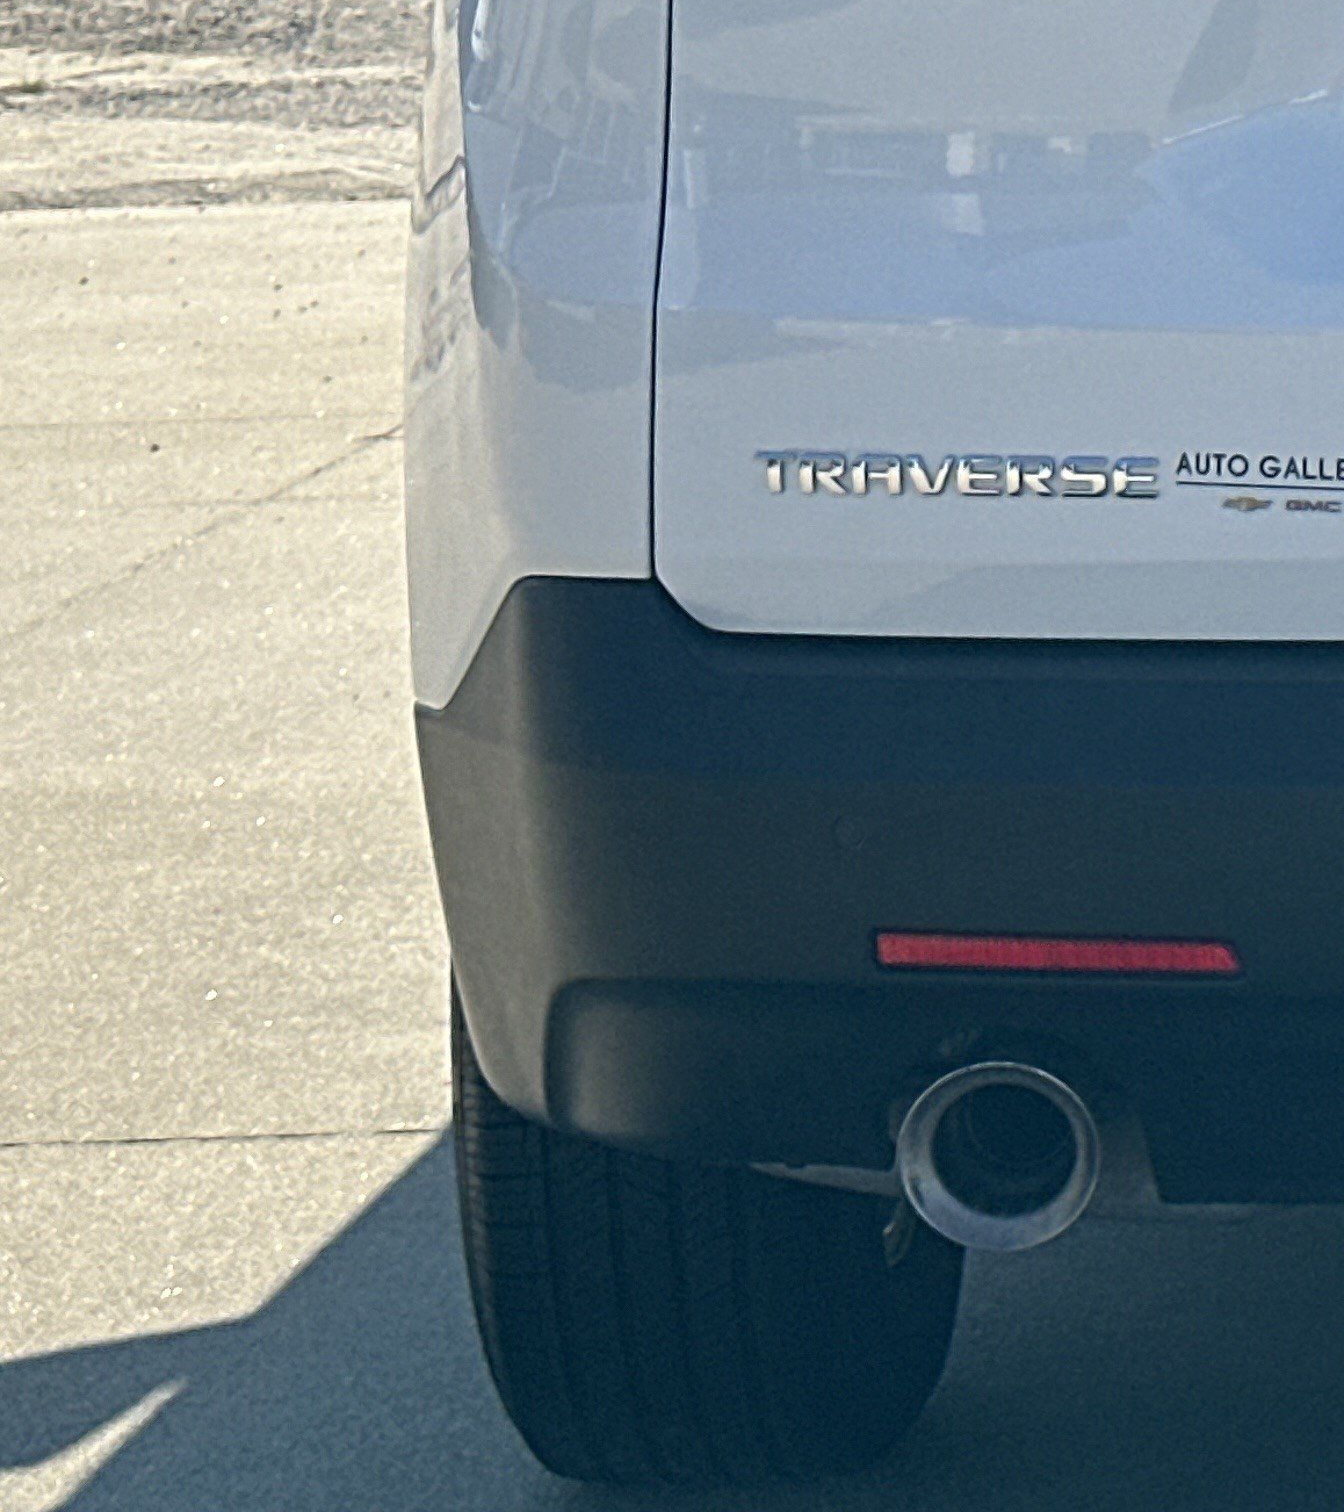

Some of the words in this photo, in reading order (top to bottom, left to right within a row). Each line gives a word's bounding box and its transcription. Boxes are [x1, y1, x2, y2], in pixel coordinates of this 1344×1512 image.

[754, 450, 1161, 499] TRAVERSE
[1176, 451, 1250, 477] AUTO
[1285, 499, 1342, 512] GMC
